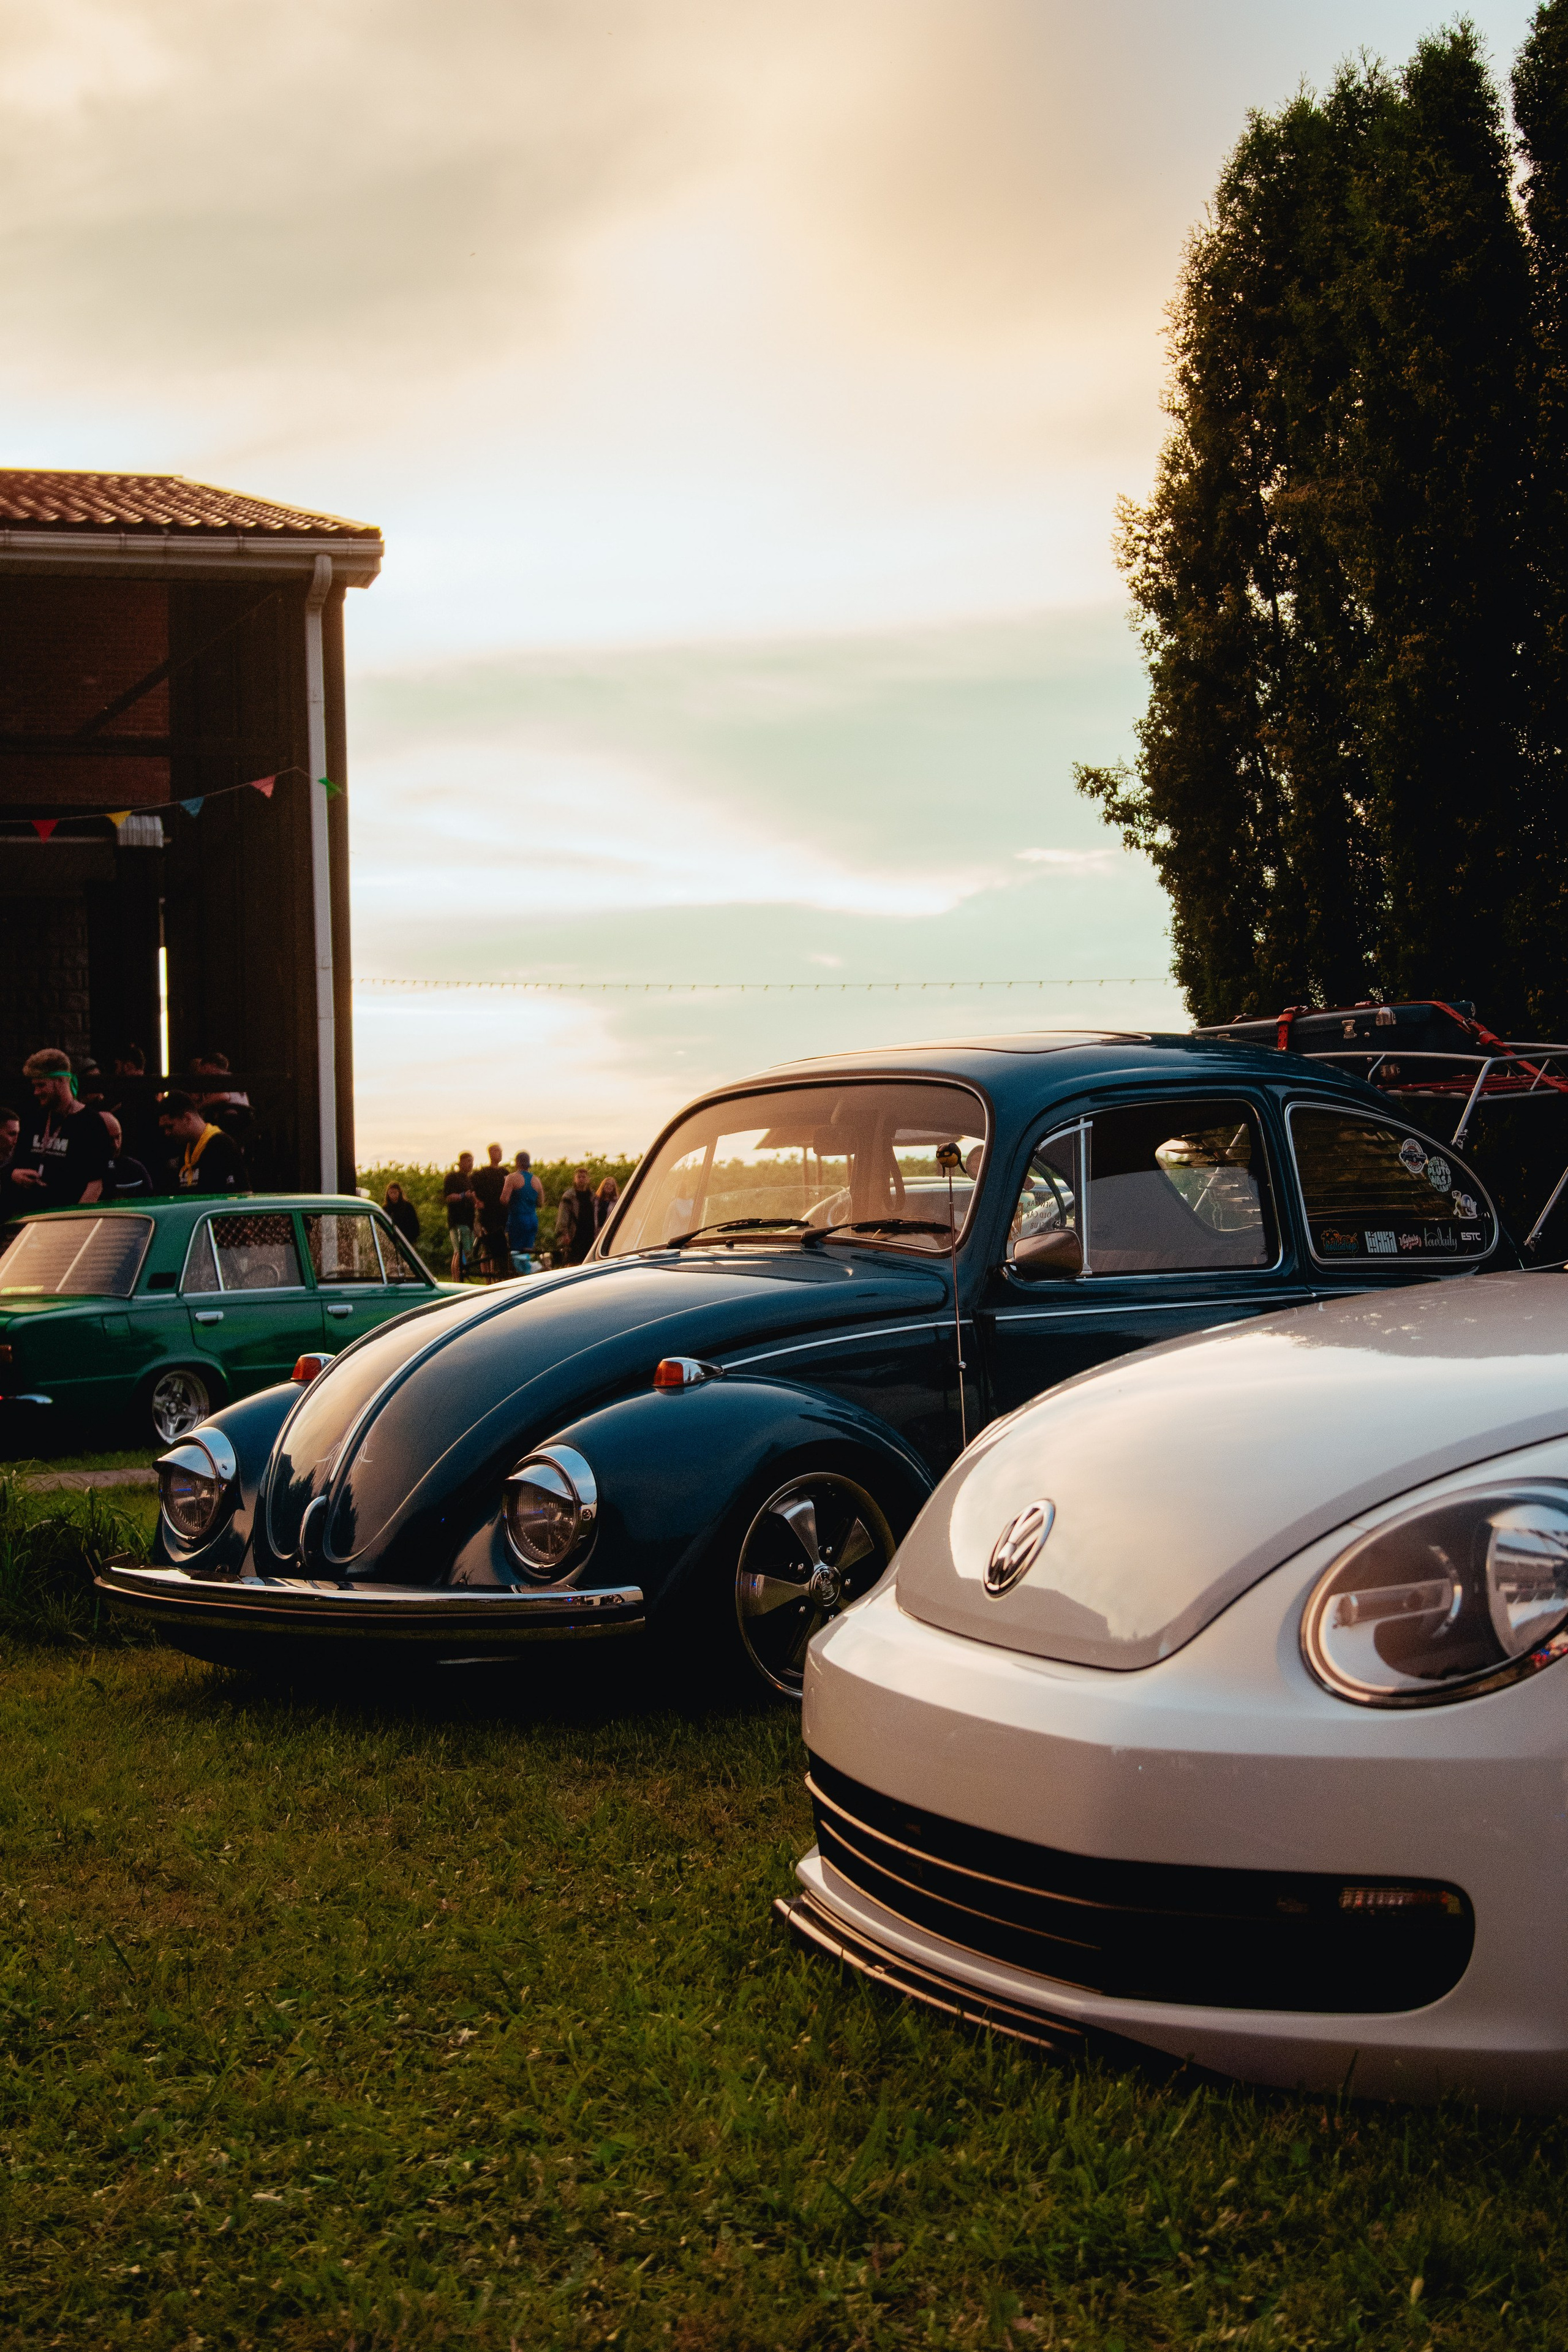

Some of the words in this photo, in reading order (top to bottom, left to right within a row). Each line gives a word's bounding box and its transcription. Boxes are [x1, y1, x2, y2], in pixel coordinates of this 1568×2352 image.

[32, 1134, 69, 1152] LM
[1428, 1166, 1451, 1175] PLUTO
[1460, 1232, 1482, 1241] ESTC
[984, 1498, 1055, 1598] VW
